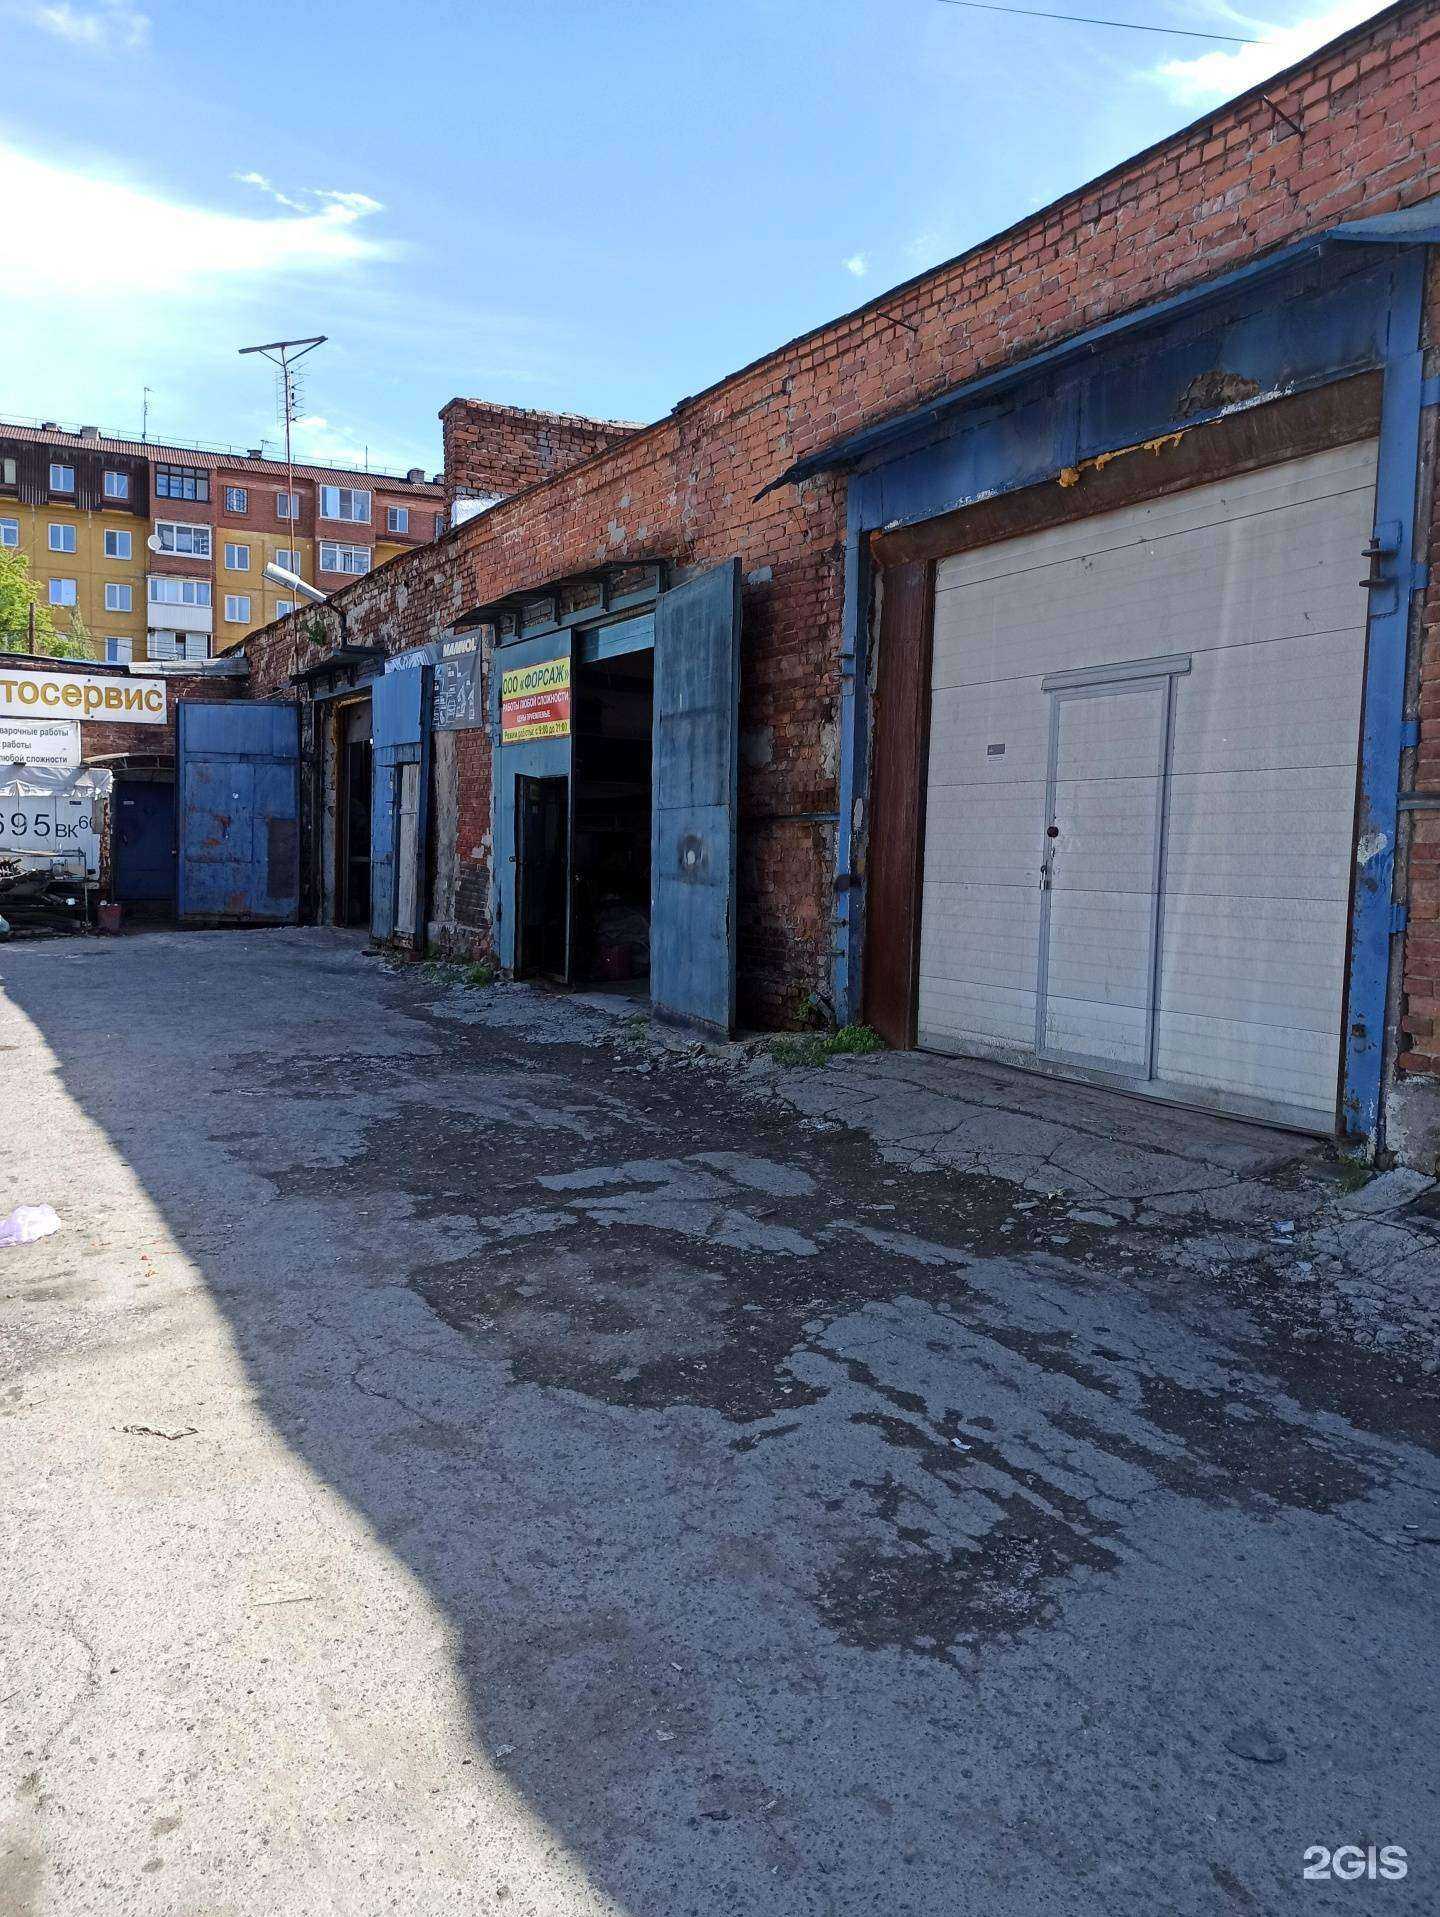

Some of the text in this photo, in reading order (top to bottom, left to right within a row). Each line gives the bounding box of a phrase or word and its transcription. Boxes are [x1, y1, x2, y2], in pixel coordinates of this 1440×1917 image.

[503, 676, 518, 695] ООО
[0, 680, 164, 715] тосервис
[39, 727, 69, 738] работы
[2, 740, 32, 749] работы
[26, 755, 68, 763] сложности
